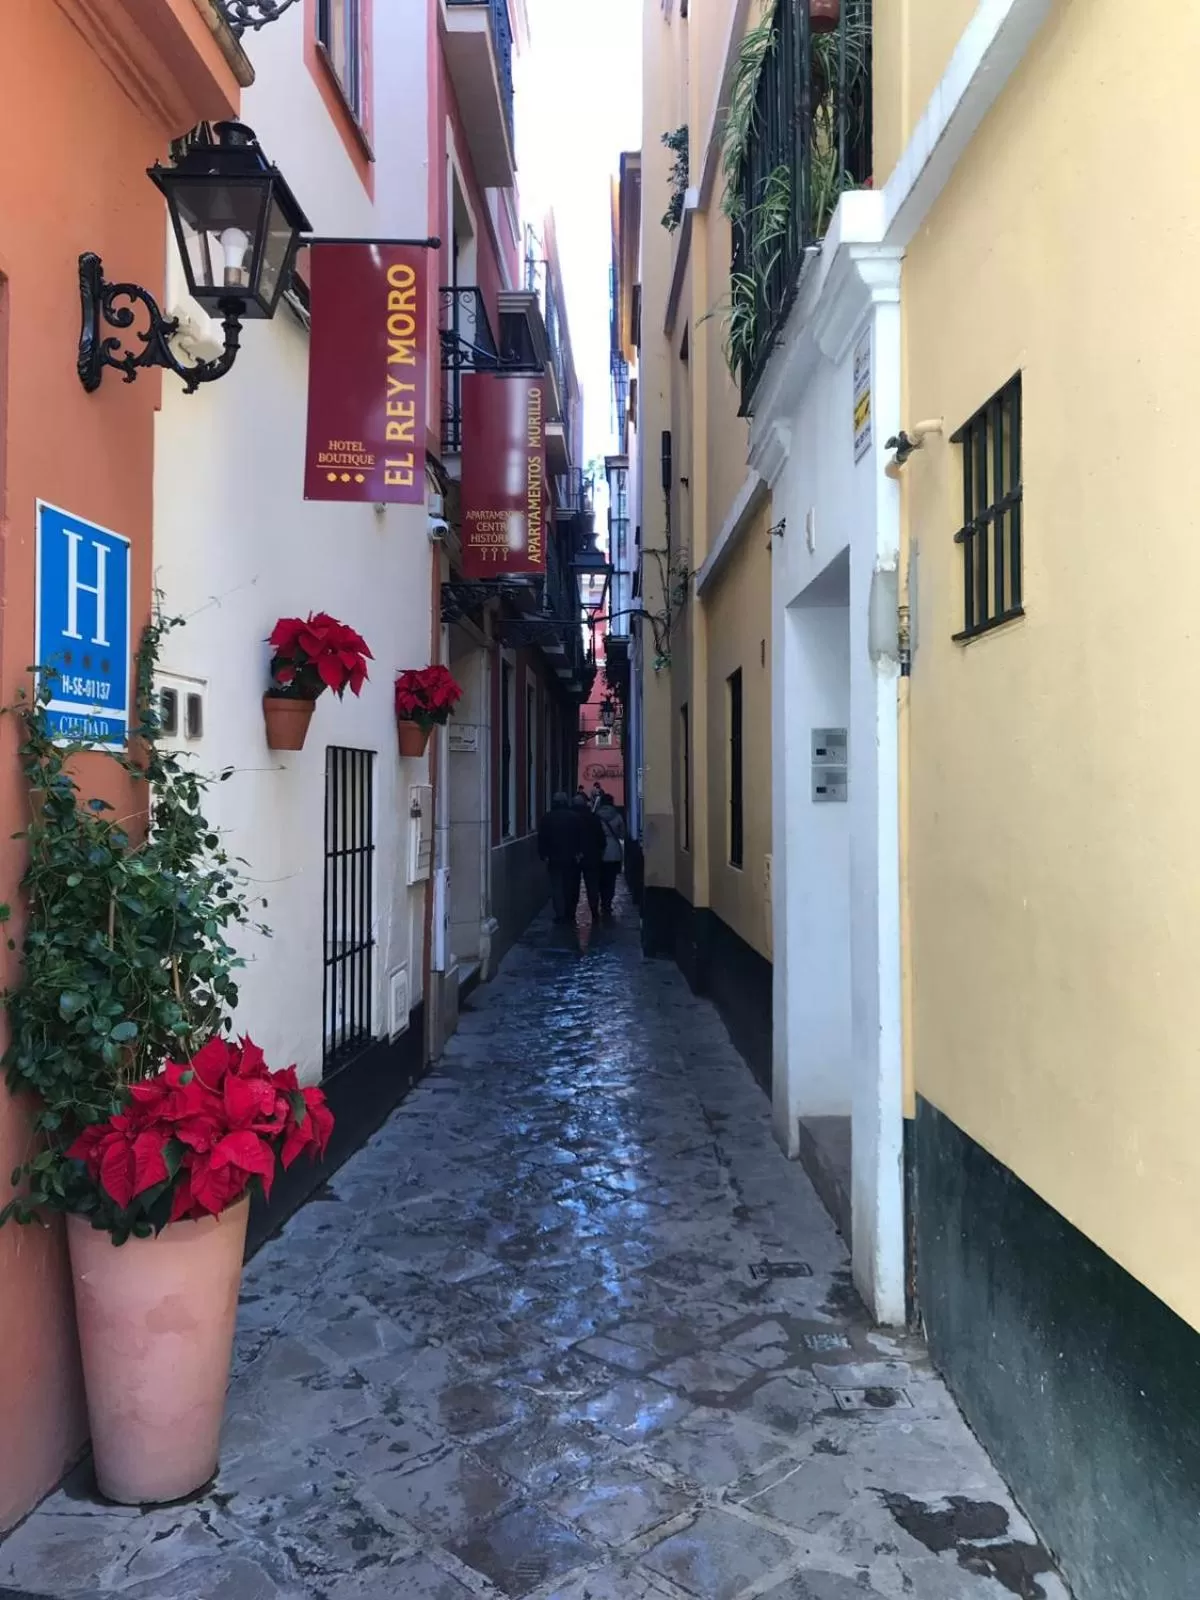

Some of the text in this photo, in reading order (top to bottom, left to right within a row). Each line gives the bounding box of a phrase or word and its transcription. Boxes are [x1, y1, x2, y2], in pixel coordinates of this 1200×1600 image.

[383, 263, 417, 487] EL REY MORO
[328, 440, 366, 452] HOTEL
[318, 452, 375, 466] BOUTIQUE
[527, 387, 542, 563] APARTAMENTOS MURILLO
[465, 510, 525, 521] APARTAMENS
[476, 521, 511, 532] CENTR
[62, 528, 111, 648] H
[62, 674, 111, 701] H-SE-01137
